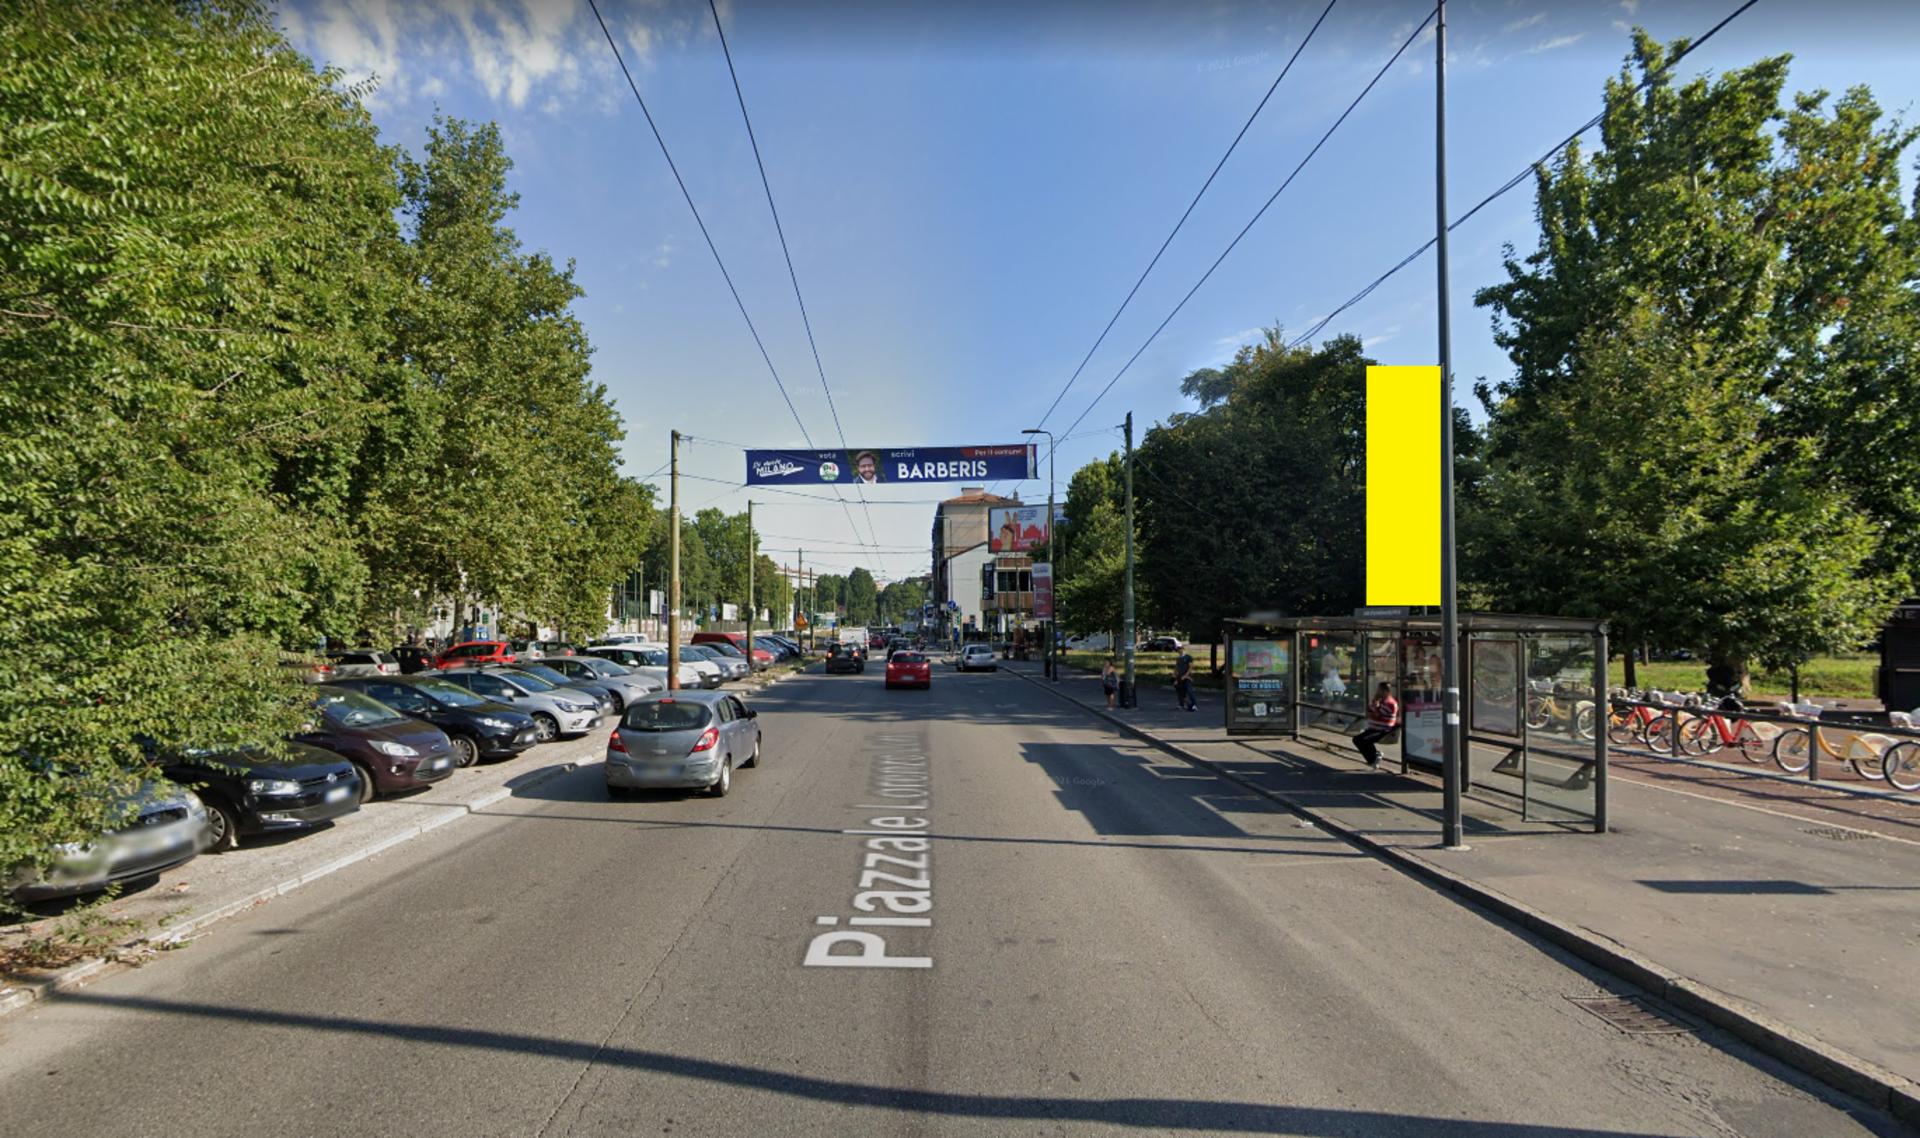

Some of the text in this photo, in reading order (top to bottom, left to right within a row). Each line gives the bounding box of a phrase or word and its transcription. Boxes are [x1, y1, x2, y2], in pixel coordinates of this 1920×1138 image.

[818, 451, 836, 459] vota
[890, 450, 915, 458] scrivi
[897, 461, 988, 479] BARBERIS
